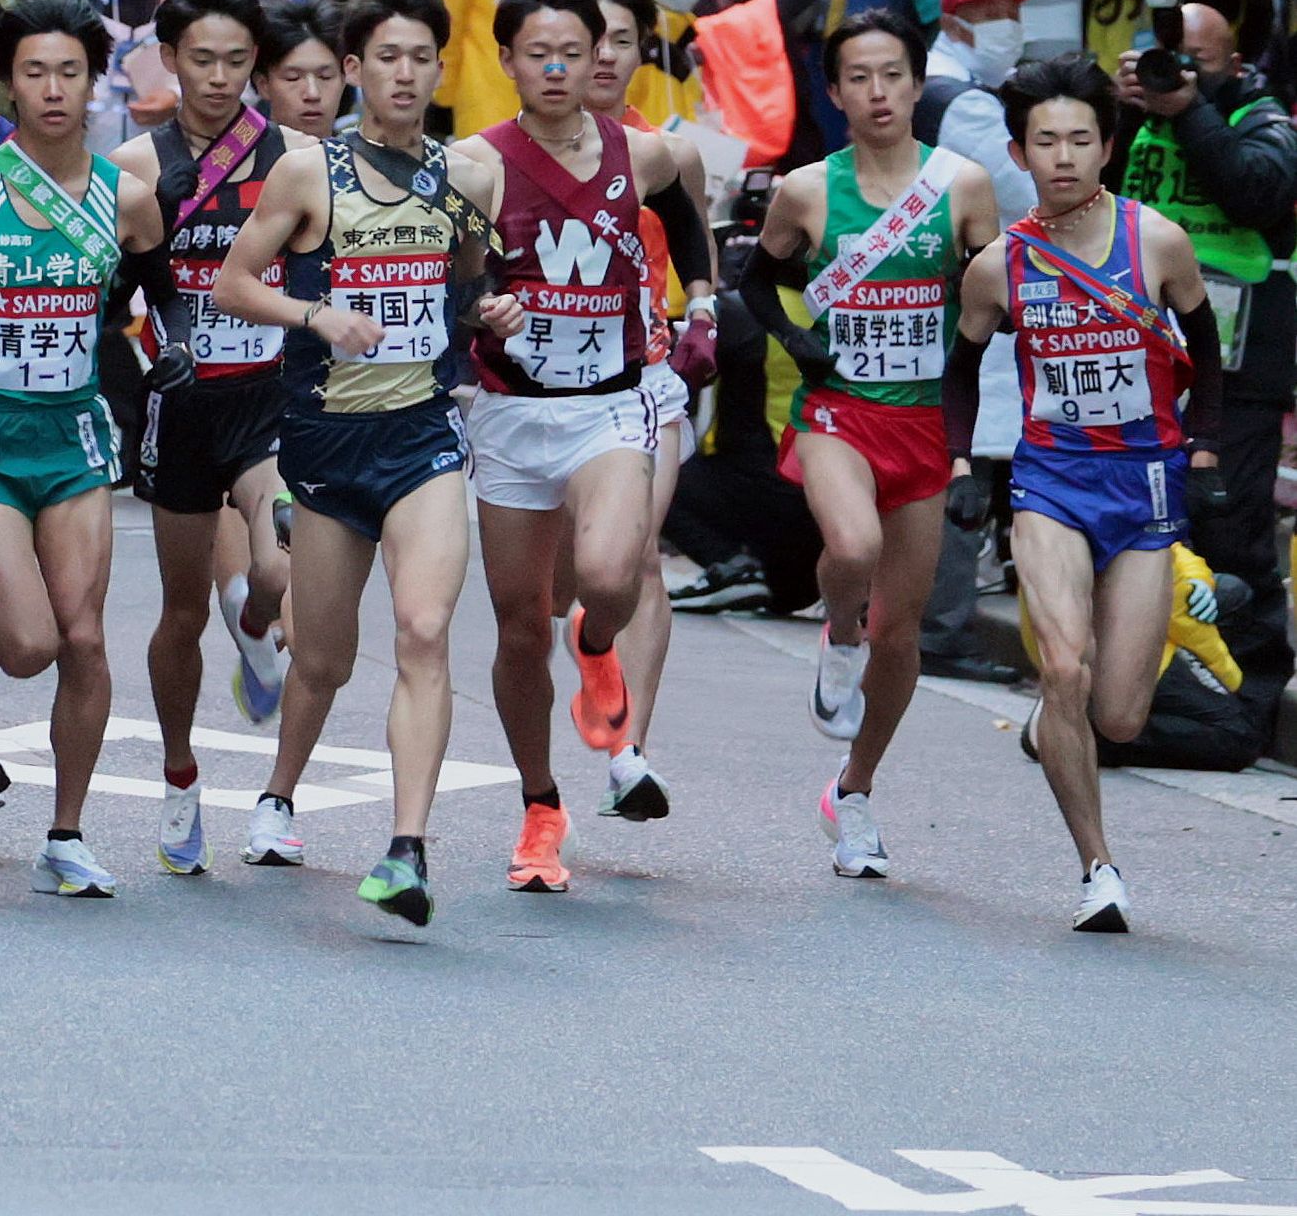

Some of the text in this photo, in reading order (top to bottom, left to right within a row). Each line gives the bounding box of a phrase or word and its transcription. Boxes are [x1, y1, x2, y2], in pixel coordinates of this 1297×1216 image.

[342, 225, 444, 249] 東京國際
[534, 219, 613, 286] W
[360, 260, 445, 283] SAPPORO
[12, 291, 97, 314] SAPPORO
[346, 289, 435, 327] 東国大
[537, 290, 623, 313] SAPPORO
[855, 285, 942, 306] SAPPORO
[834, 311, 940, 349] 関東学生連合
[1048, 328, 1141, 352] SAPPORO
[18, 362, 71, 388] 1-1
[530, 355, 600, 384] 7-15
[853, 351, 921, 377] 21-1
[1042, 356, 1134, 396] 創価大
[1062, 400, 1122, 422] 9-1
